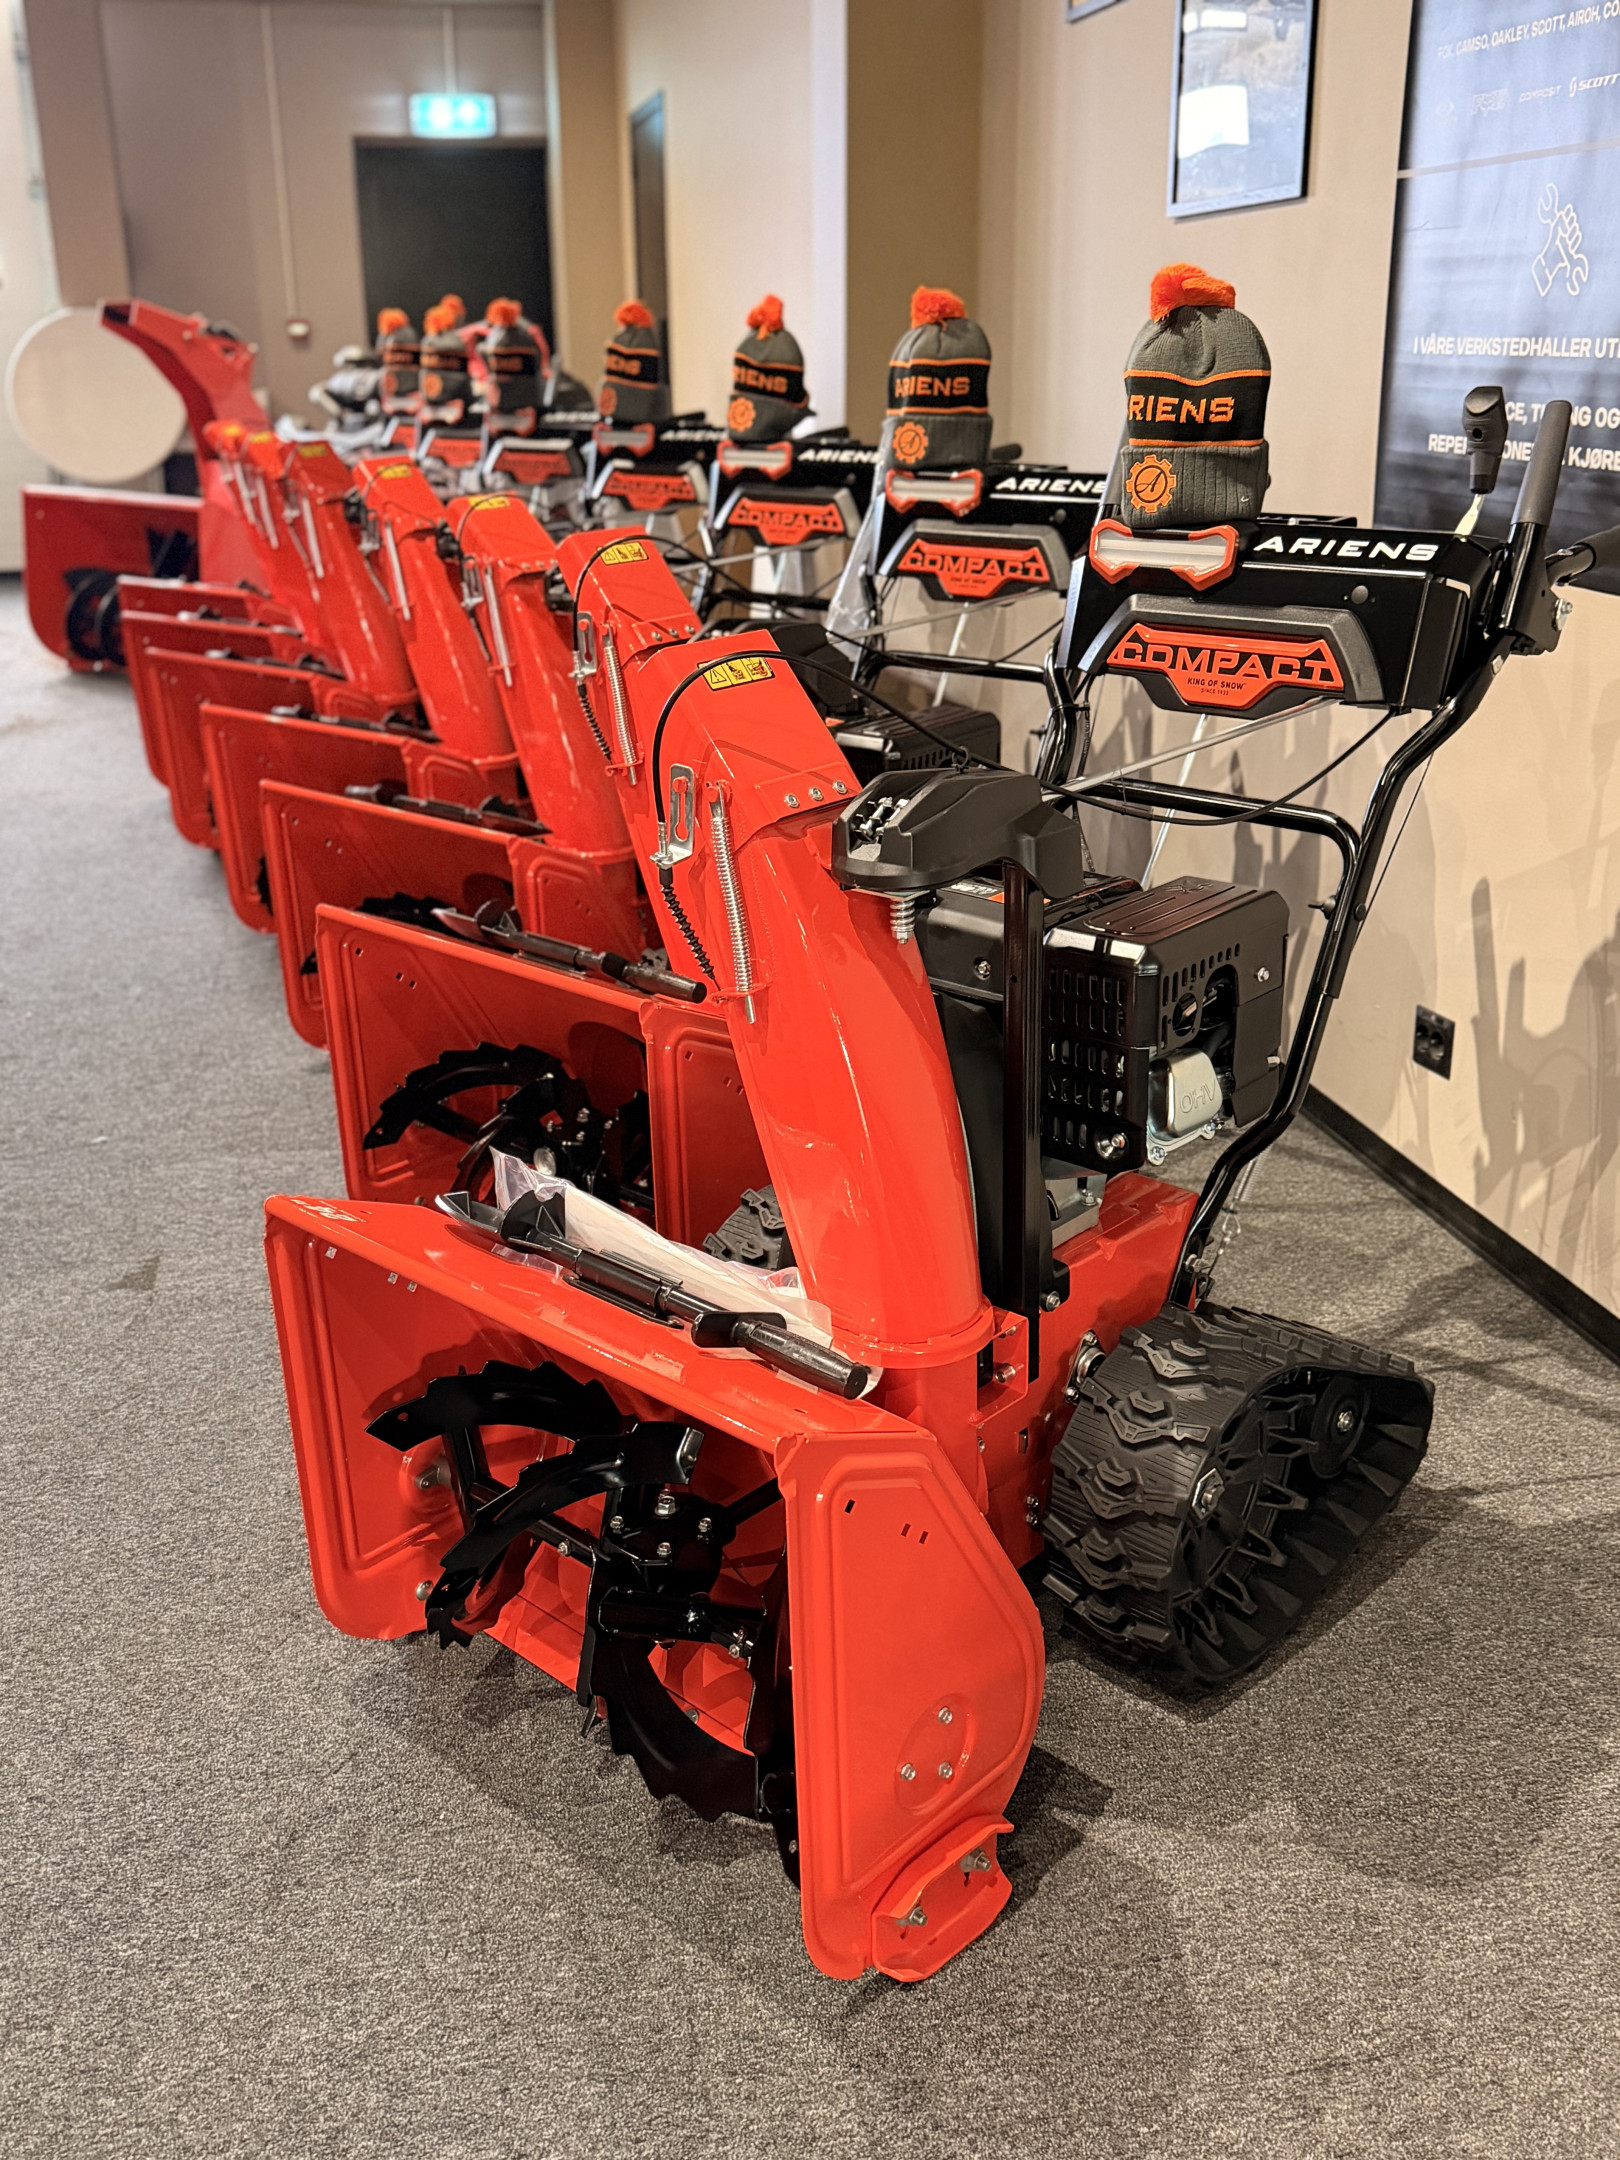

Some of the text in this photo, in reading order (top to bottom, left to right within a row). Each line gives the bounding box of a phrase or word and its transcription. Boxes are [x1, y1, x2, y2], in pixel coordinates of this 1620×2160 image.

[1491, 23, 1530, 47] OAKLEY,
[1531, 13, 1566, 38] SCOTT,
[1567, 5, 1601, 28] AIROH,
[1602, 0, 1620, 19] CO
[1577, 73, 1620, 91] SCOTT
[1413, 332, 1620, 359] I VÅRE VERKSTEDHALLER UT
[1128, 394, 1235, 424] RIENS
[1594, 407, 1620, 430] OG
[1253, 535, 1439, 562] ARIENS
[904, 552, 1044, 578] COMPACT
[1114, 641, 1335, 683] COMPACT
[1187, 677, 1206, 686] KING
[1207, 679, 1218, 688] OF
[1180, 1079, 1216, 1114] OHV
